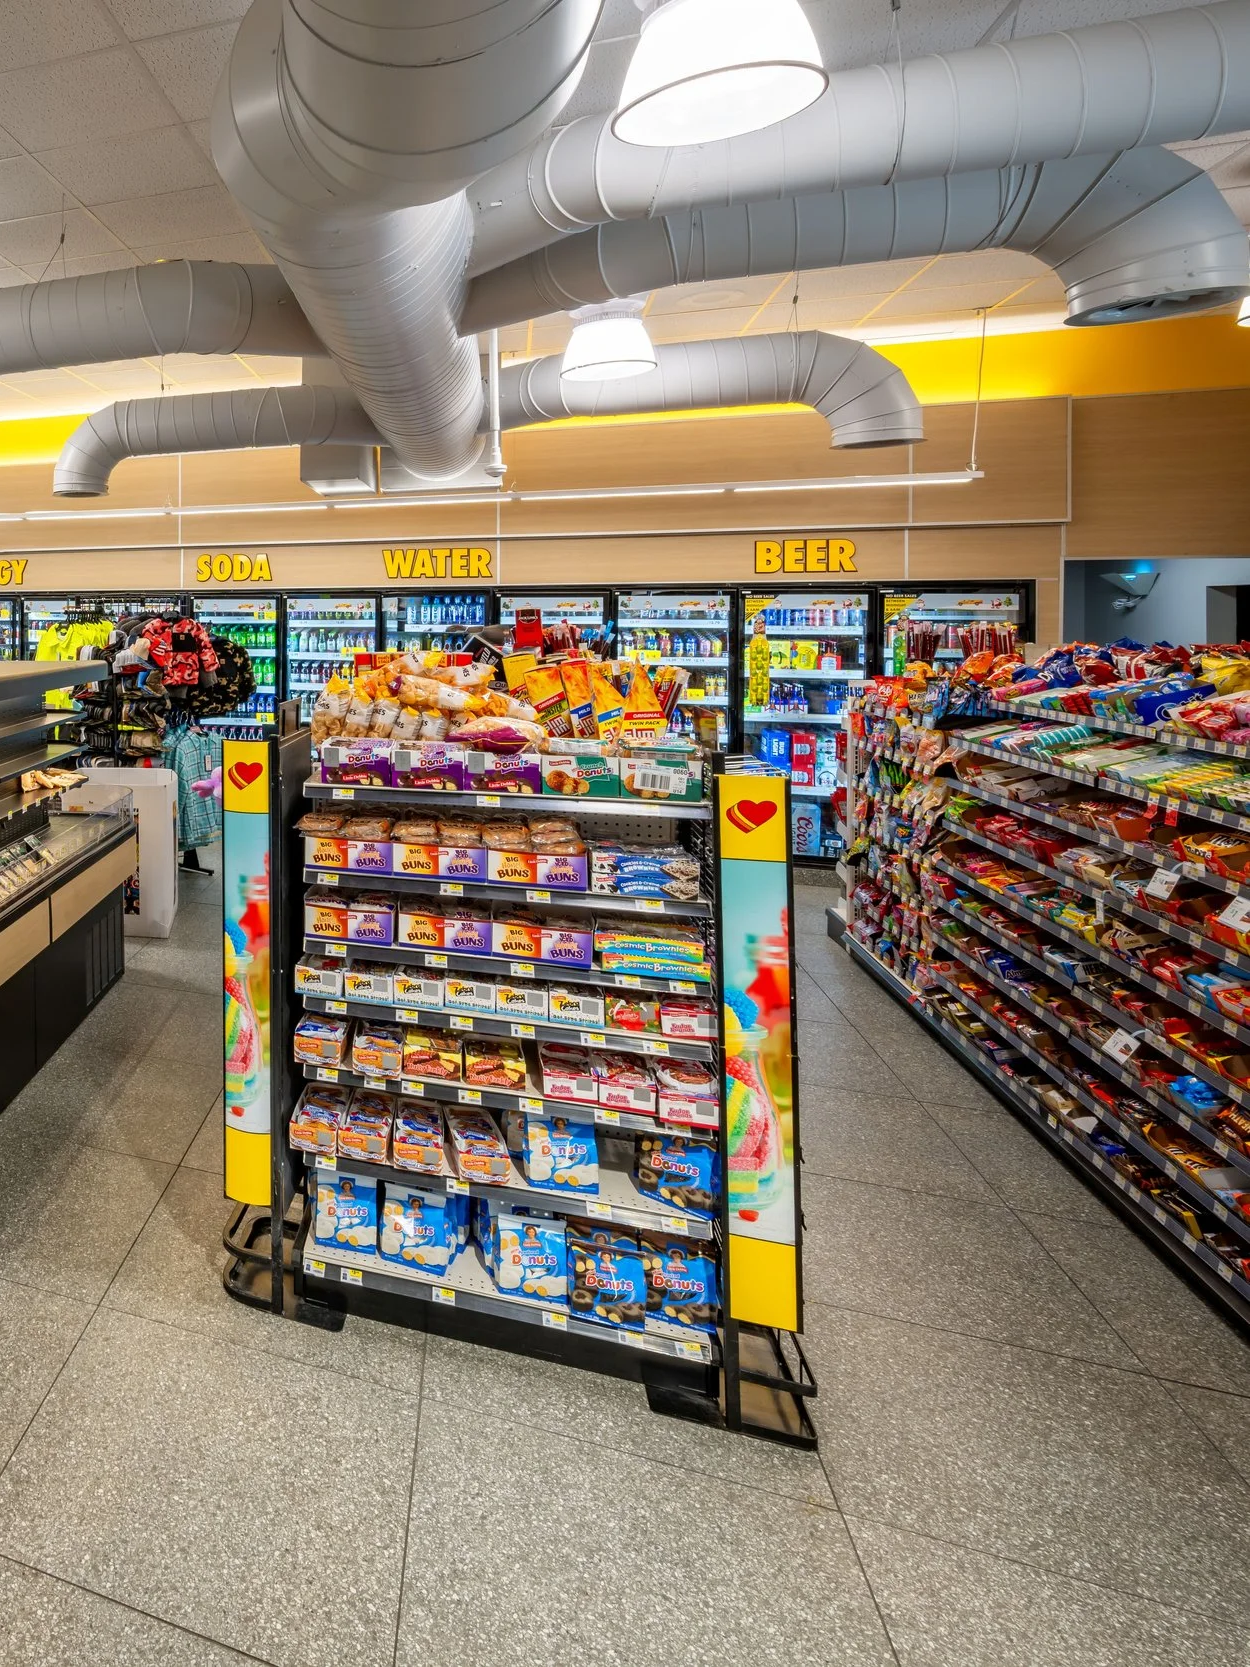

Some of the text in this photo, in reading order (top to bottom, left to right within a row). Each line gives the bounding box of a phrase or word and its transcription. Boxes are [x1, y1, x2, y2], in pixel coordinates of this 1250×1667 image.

[754, 538, 858, 573] BEER
[196, 553, 273, 582] SODA
[382, 548, 493, 579] WATER
[578, 707, 591, 715] MILD
[348, 753, 380, 764] Donuts
[420, 755, 453, 767] Donuts
[494, 758, 529, 769] Donuts
[576, 768, 612, 778] Donuts
[796, 816, 814, 853] Coors
[313, 853, 341, 863] BUNS
[356, 858, 385, 868] BUNS
[401, 860, 432, 870] BUNS
[447, 864, 479, 875] BUNS
[497, 868, 530, 879] BUNS
[546, 873, 579, 883] BUNS
[313, 923, 341, 933] BUNS
[356, 928, 385, 938] BUNS
[407, 931, 437, 942] BUNS
[453, 937, 484, 947] BUNS
[501, 941, 534, 952] BUNS
[645, 944, 690, 953] Brownies
[550, 949, 584, 959] BUNS
[622, 962, 698, 973] Cosmic Brownies
[541, 1144, 586, 1157] Donuts
[651, 1155, 700, 1176] Donuts
[511, 1254, 557, 1266] Donuts
[585, 1275, 633, 1291] Donuts
[652, 1274, 704, 1291] Donuts
